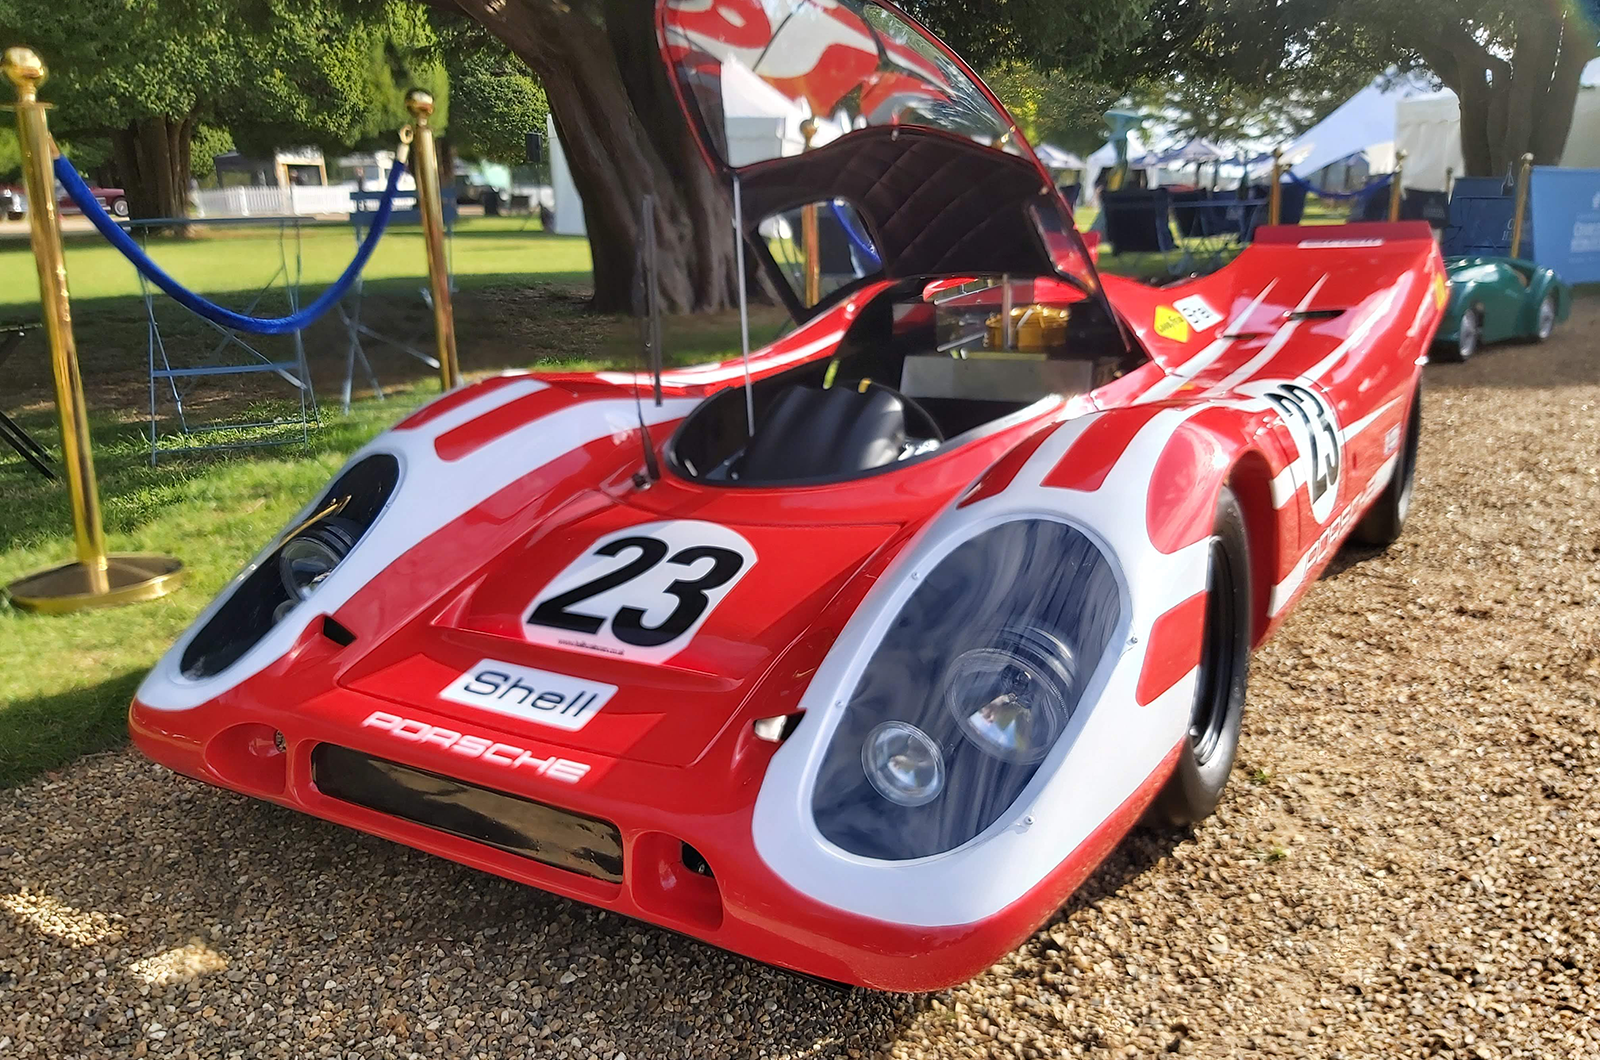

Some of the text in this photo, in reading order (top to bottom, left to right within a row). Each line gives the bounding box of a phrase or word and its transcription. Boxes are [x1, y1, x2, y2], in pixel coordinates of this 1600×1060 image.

[1263, 384, 1339, 505] 23
[526, 536, 744, 647] 23
[463, 670, 600, 717] Shell
[361, 710, 592, 784] PORSCHE
